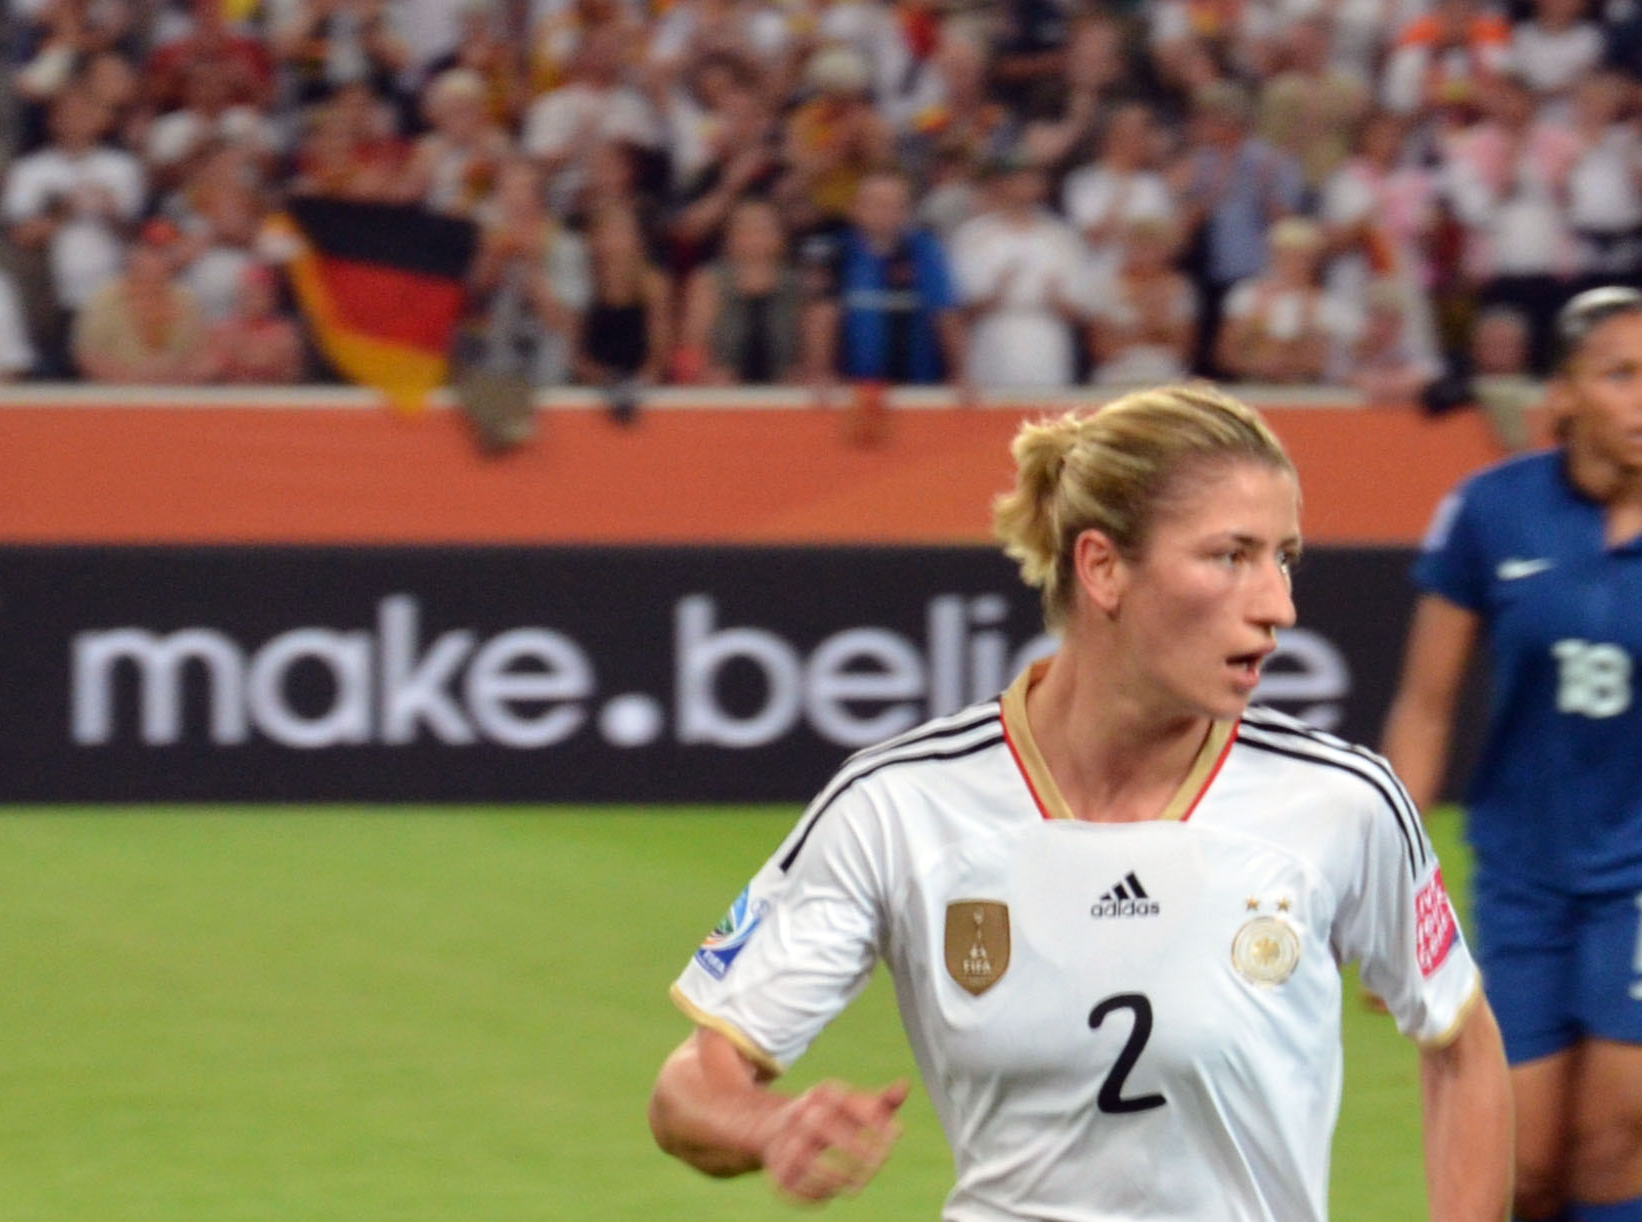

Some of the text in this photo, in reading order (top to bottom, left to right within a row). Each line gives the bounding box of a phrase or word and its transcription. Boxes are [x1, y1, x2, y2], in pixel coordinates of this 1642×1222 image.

[71, 592, 1350, 749] make.belie
[1552, 639, 1632, 719] 18
[1090, 901, 1161, 918] adidas
[963, 958, 992, 975] FIFA
[1088, 991, 1167, 1113] 2
